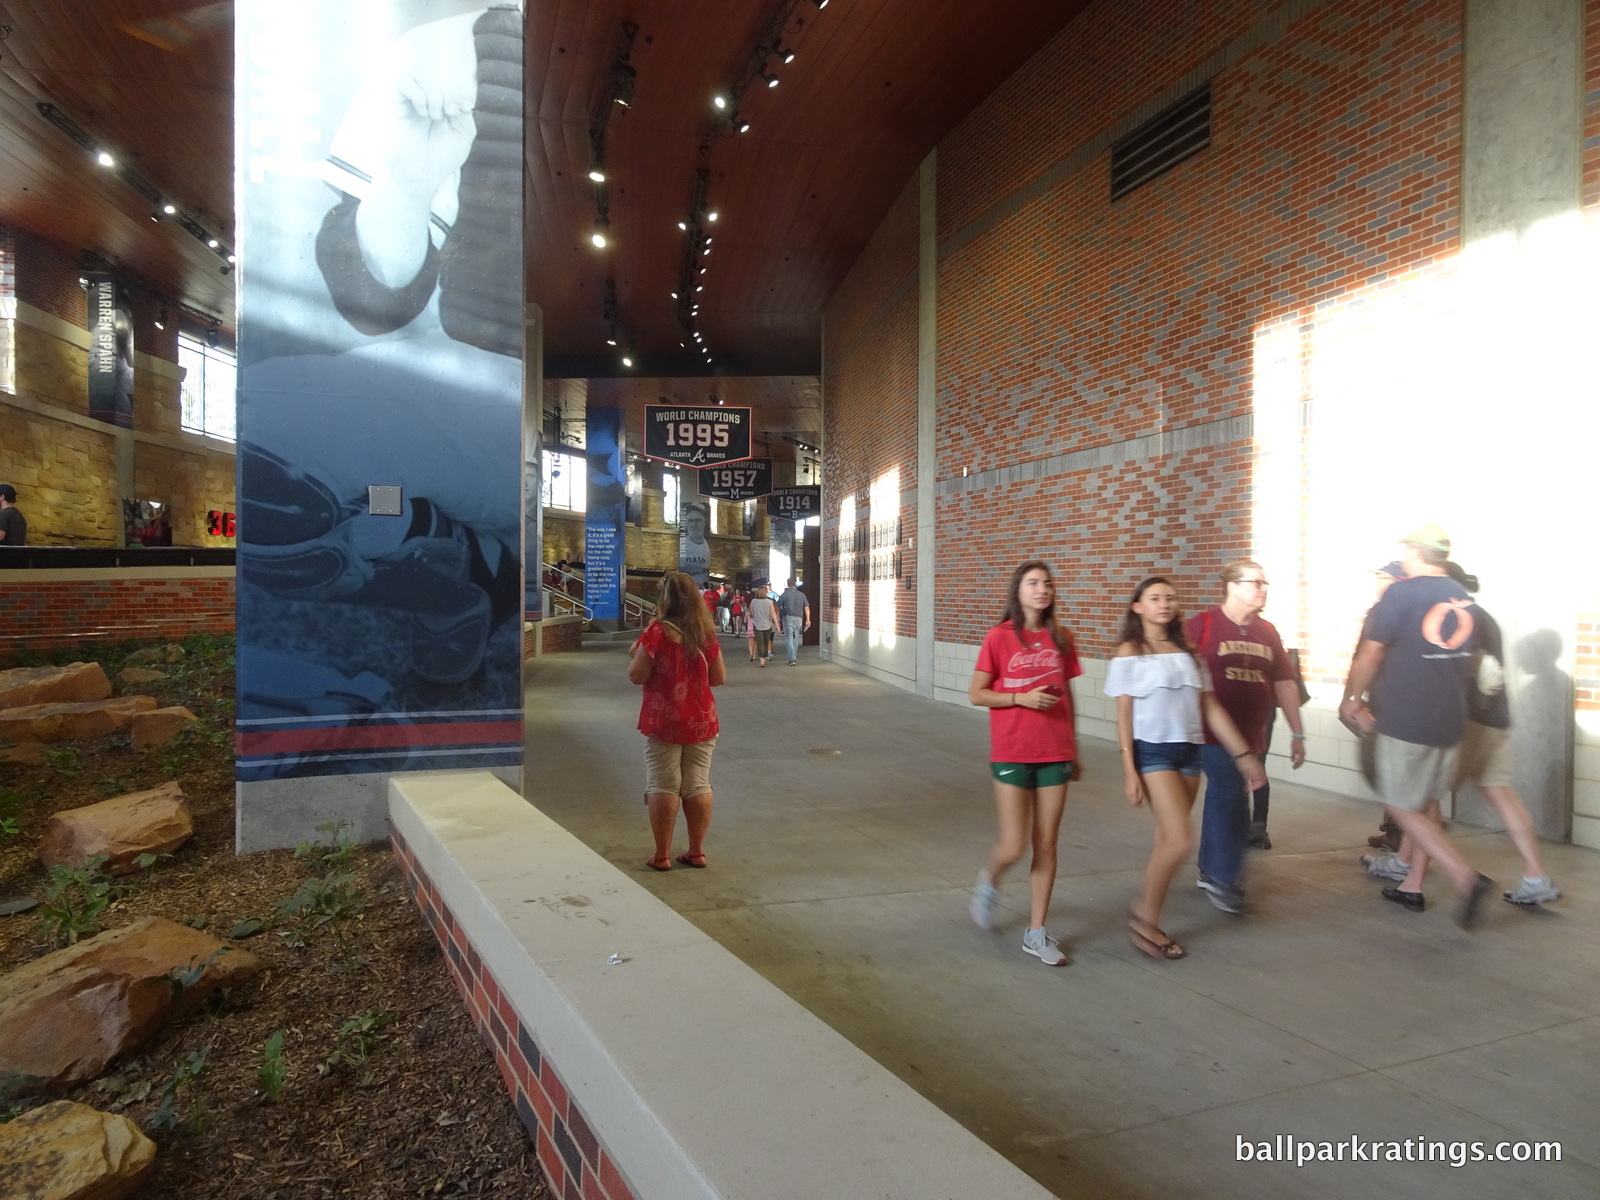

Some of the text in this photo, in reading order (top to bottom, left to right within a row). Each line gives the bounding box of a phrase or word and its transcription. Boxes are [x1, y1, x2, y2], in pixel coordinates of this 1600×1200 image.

[98, 282, 112, 372] WARREN SPAHN
[656, 410, 740, 424] WORLD CHAMPIONS
[666, 422, 729, 447] 1995
[712, 470, 757, 487] 1957
[730, 489, 739, 498] M
[779, 496, 810, 510] 1914
[208, 510, 236, 537] 36
